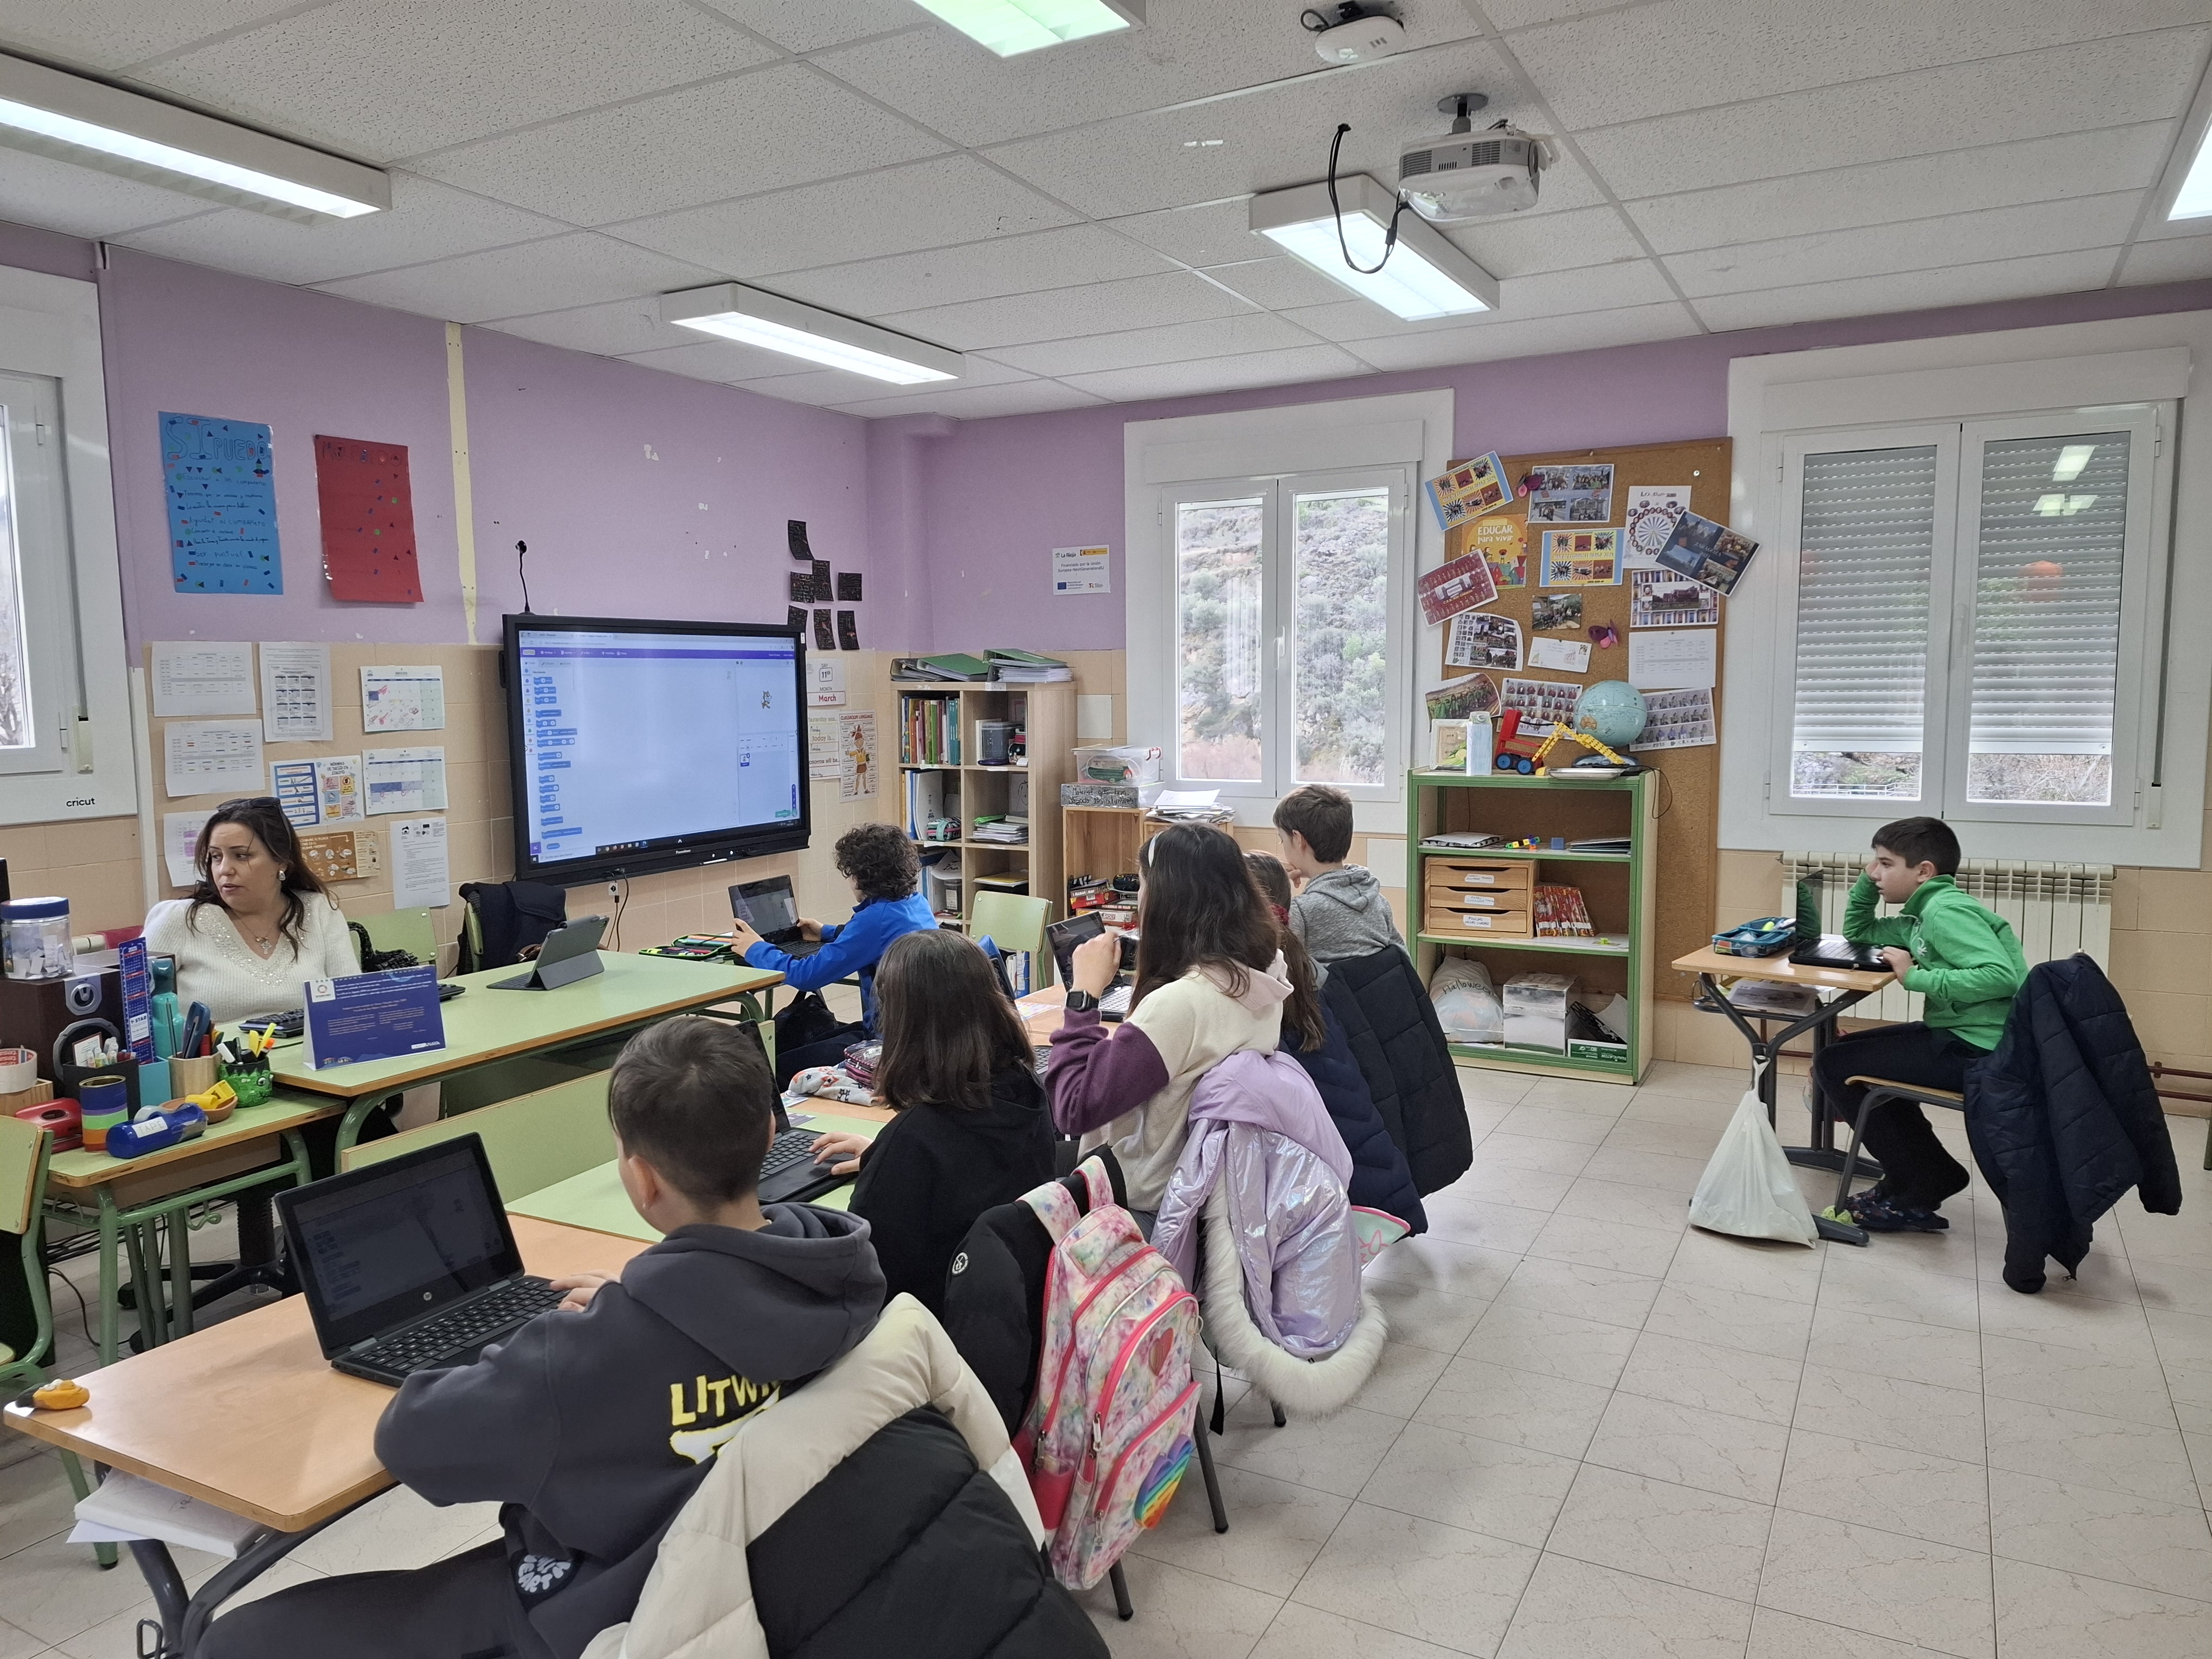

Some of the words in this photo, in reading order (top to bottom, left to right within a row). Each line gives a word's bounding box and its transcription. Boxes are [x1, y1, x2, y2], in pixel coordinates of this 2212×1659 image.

[166, 416, 212, 460] SI
[1478, 525, 1513, 535] EDUCAR
[1478, 536, 1493, 544] para
[821, 670, 831, 678] 11th
[819, 693, 837, 702] March
[66, 797, 95, 807] cricut
[1443, 979, 1495, 996] Halloween
[138, 1121, 164, 1134] TAPE
